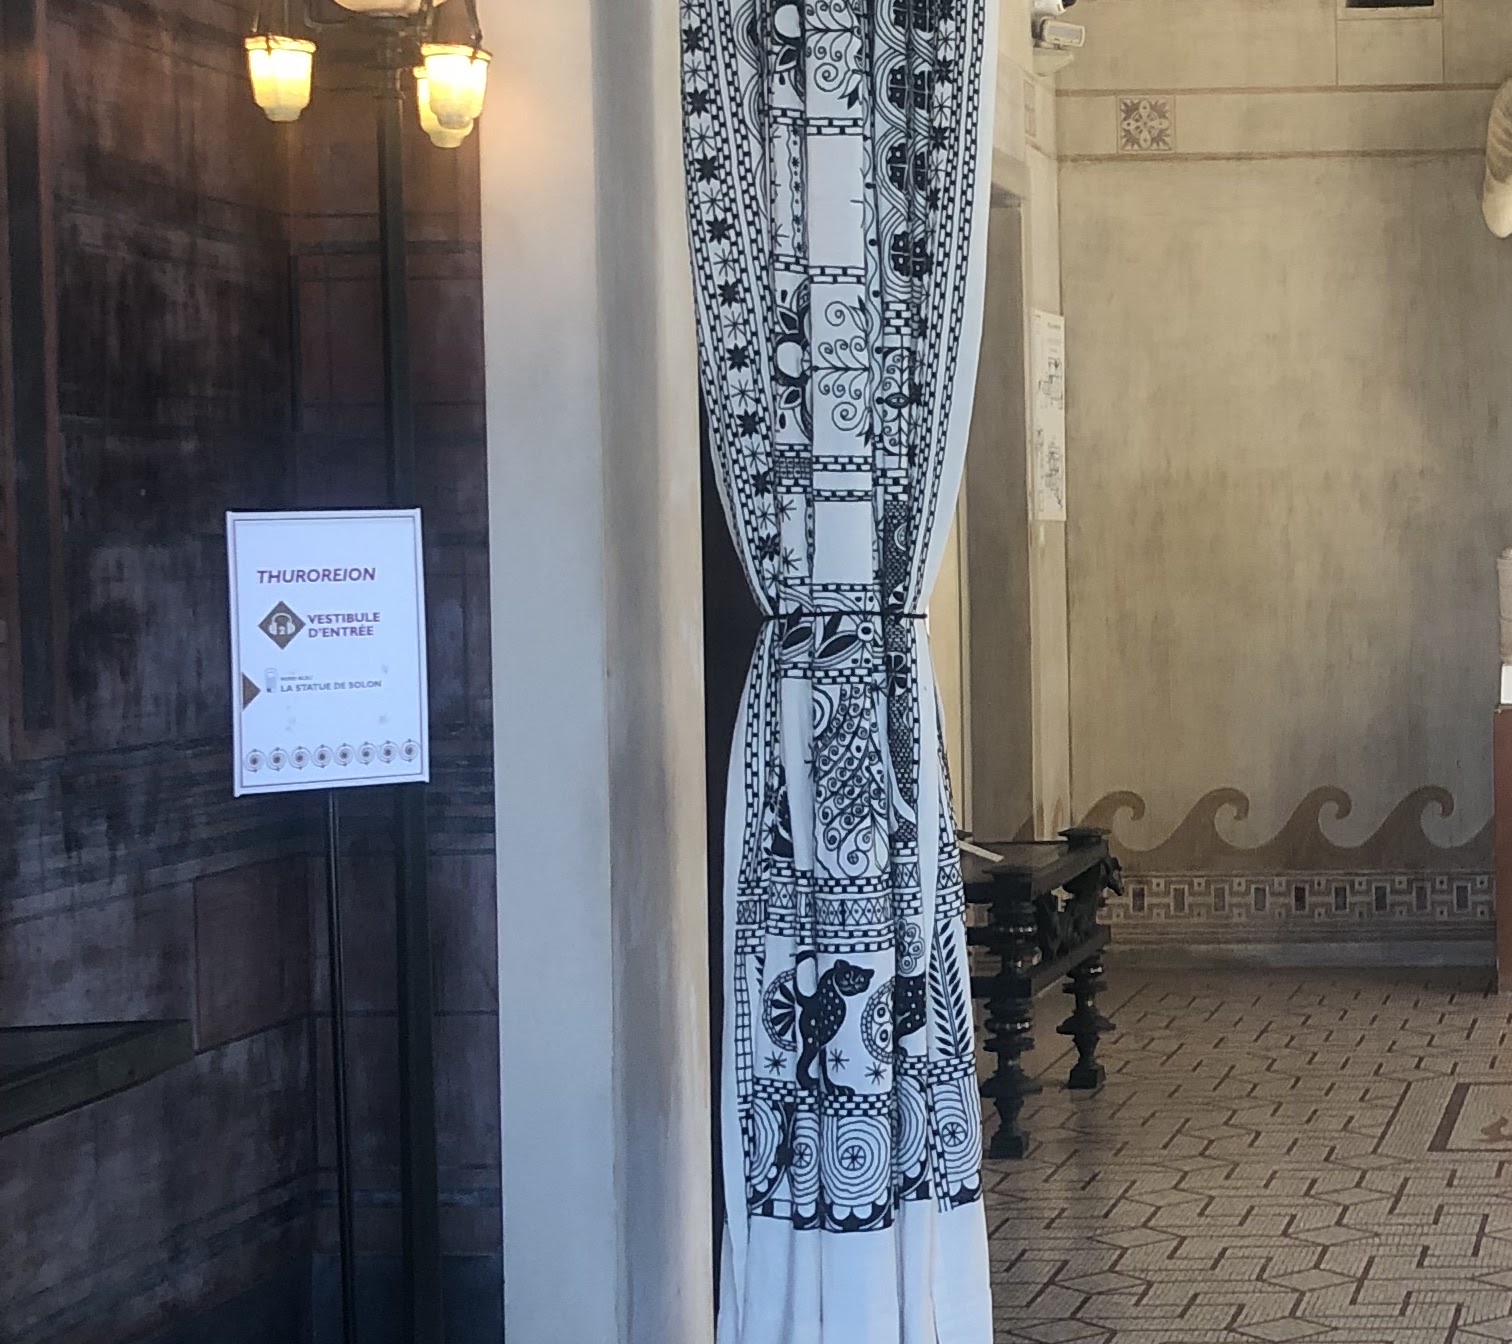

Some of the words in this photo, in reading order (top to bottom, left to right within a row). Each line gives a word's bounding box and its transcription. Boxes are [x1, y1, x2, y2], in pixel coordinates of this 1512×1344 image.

[257, 568, 375, 584] THUROREION
[307, 613, 380, 624] VESTIBULE
[308, 625, 374, 638] D'ENTRÉE
[281, 685, 293, 693] LA
[296, 683, 331, 692] STATUE
[334, 681, 345, 690] DE
[348, 680, 382, 689] SOLON
